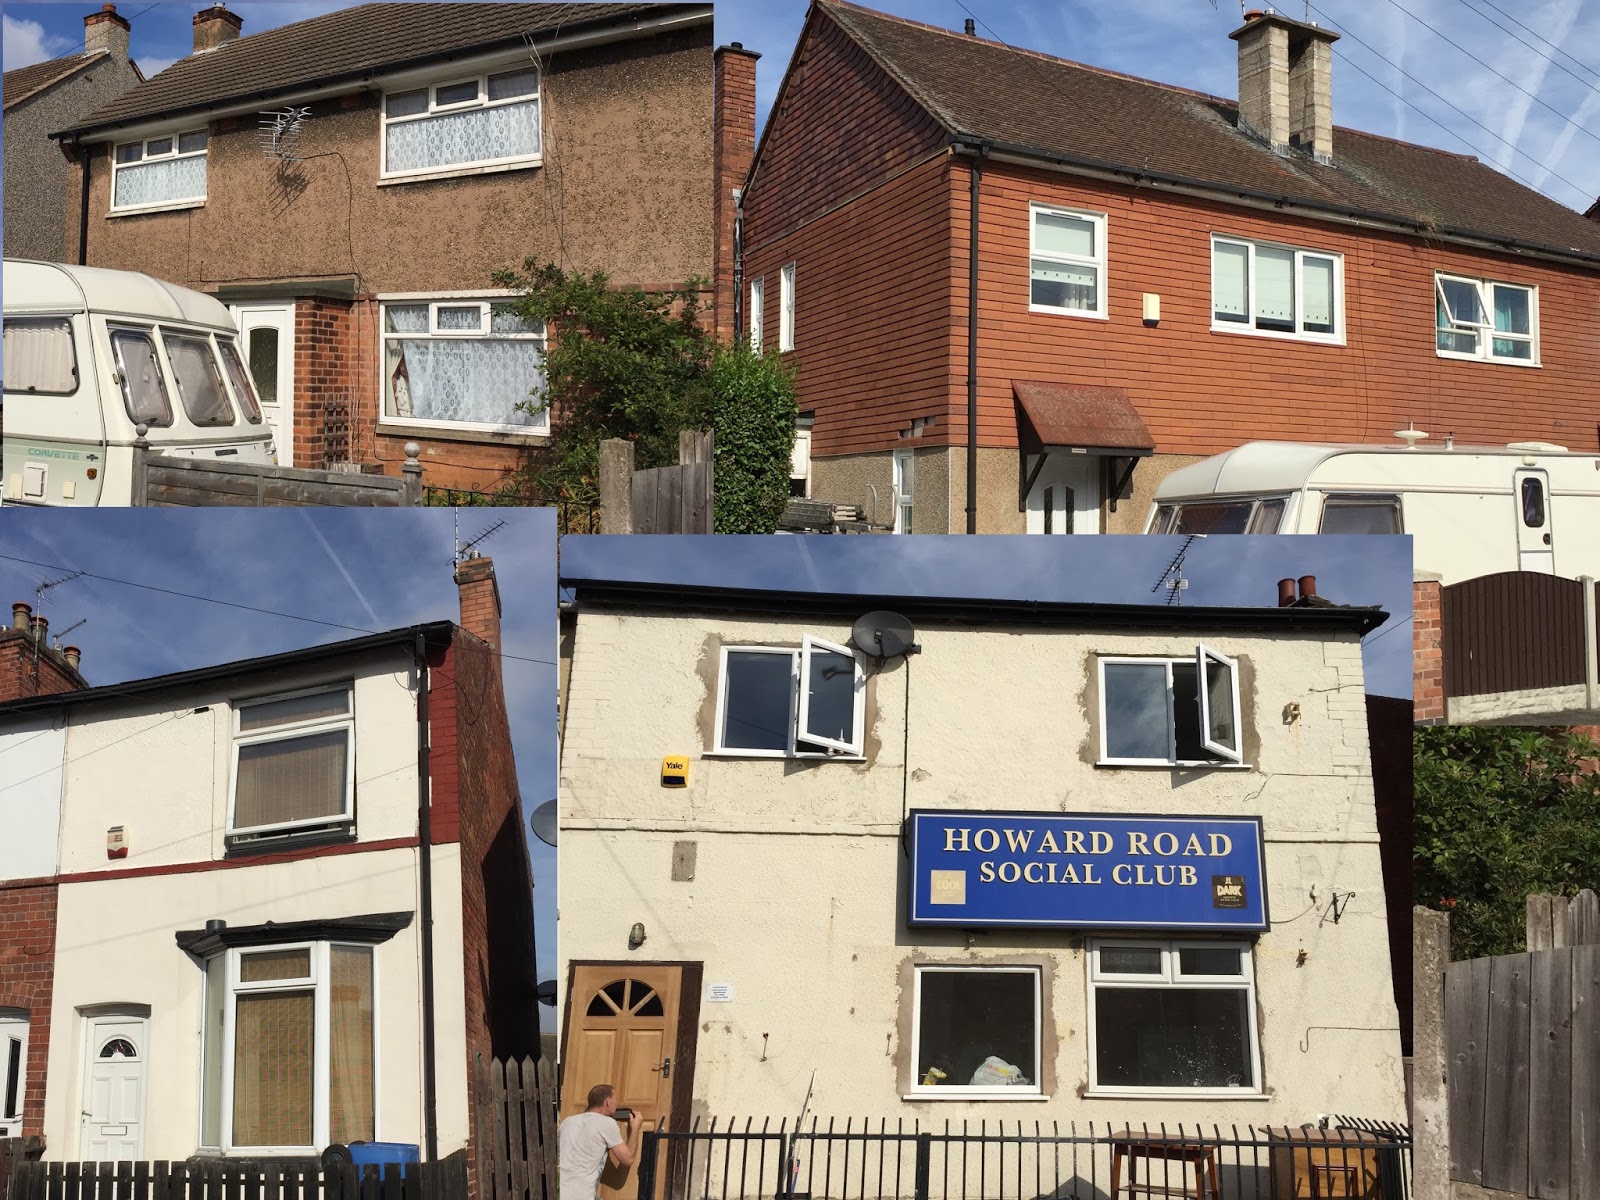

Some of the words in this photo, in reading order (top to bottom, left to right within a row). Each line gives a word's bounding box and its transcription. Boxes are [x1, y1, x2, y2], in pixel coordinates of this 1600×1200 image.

[27, 447, 80, 460] CORVETTE
[666, 761, 683, 769] Yale
[943, 828, 1114, 854] HOWARD
[1126, 831, 1233, 857] ROAD
[979, 861, 1102, 884] SOCIAL
[1112, 863, 1198, 886] CLUB
[936, 880, 961, 890] COOL
[1216, 884, 1243, 897] DARK
